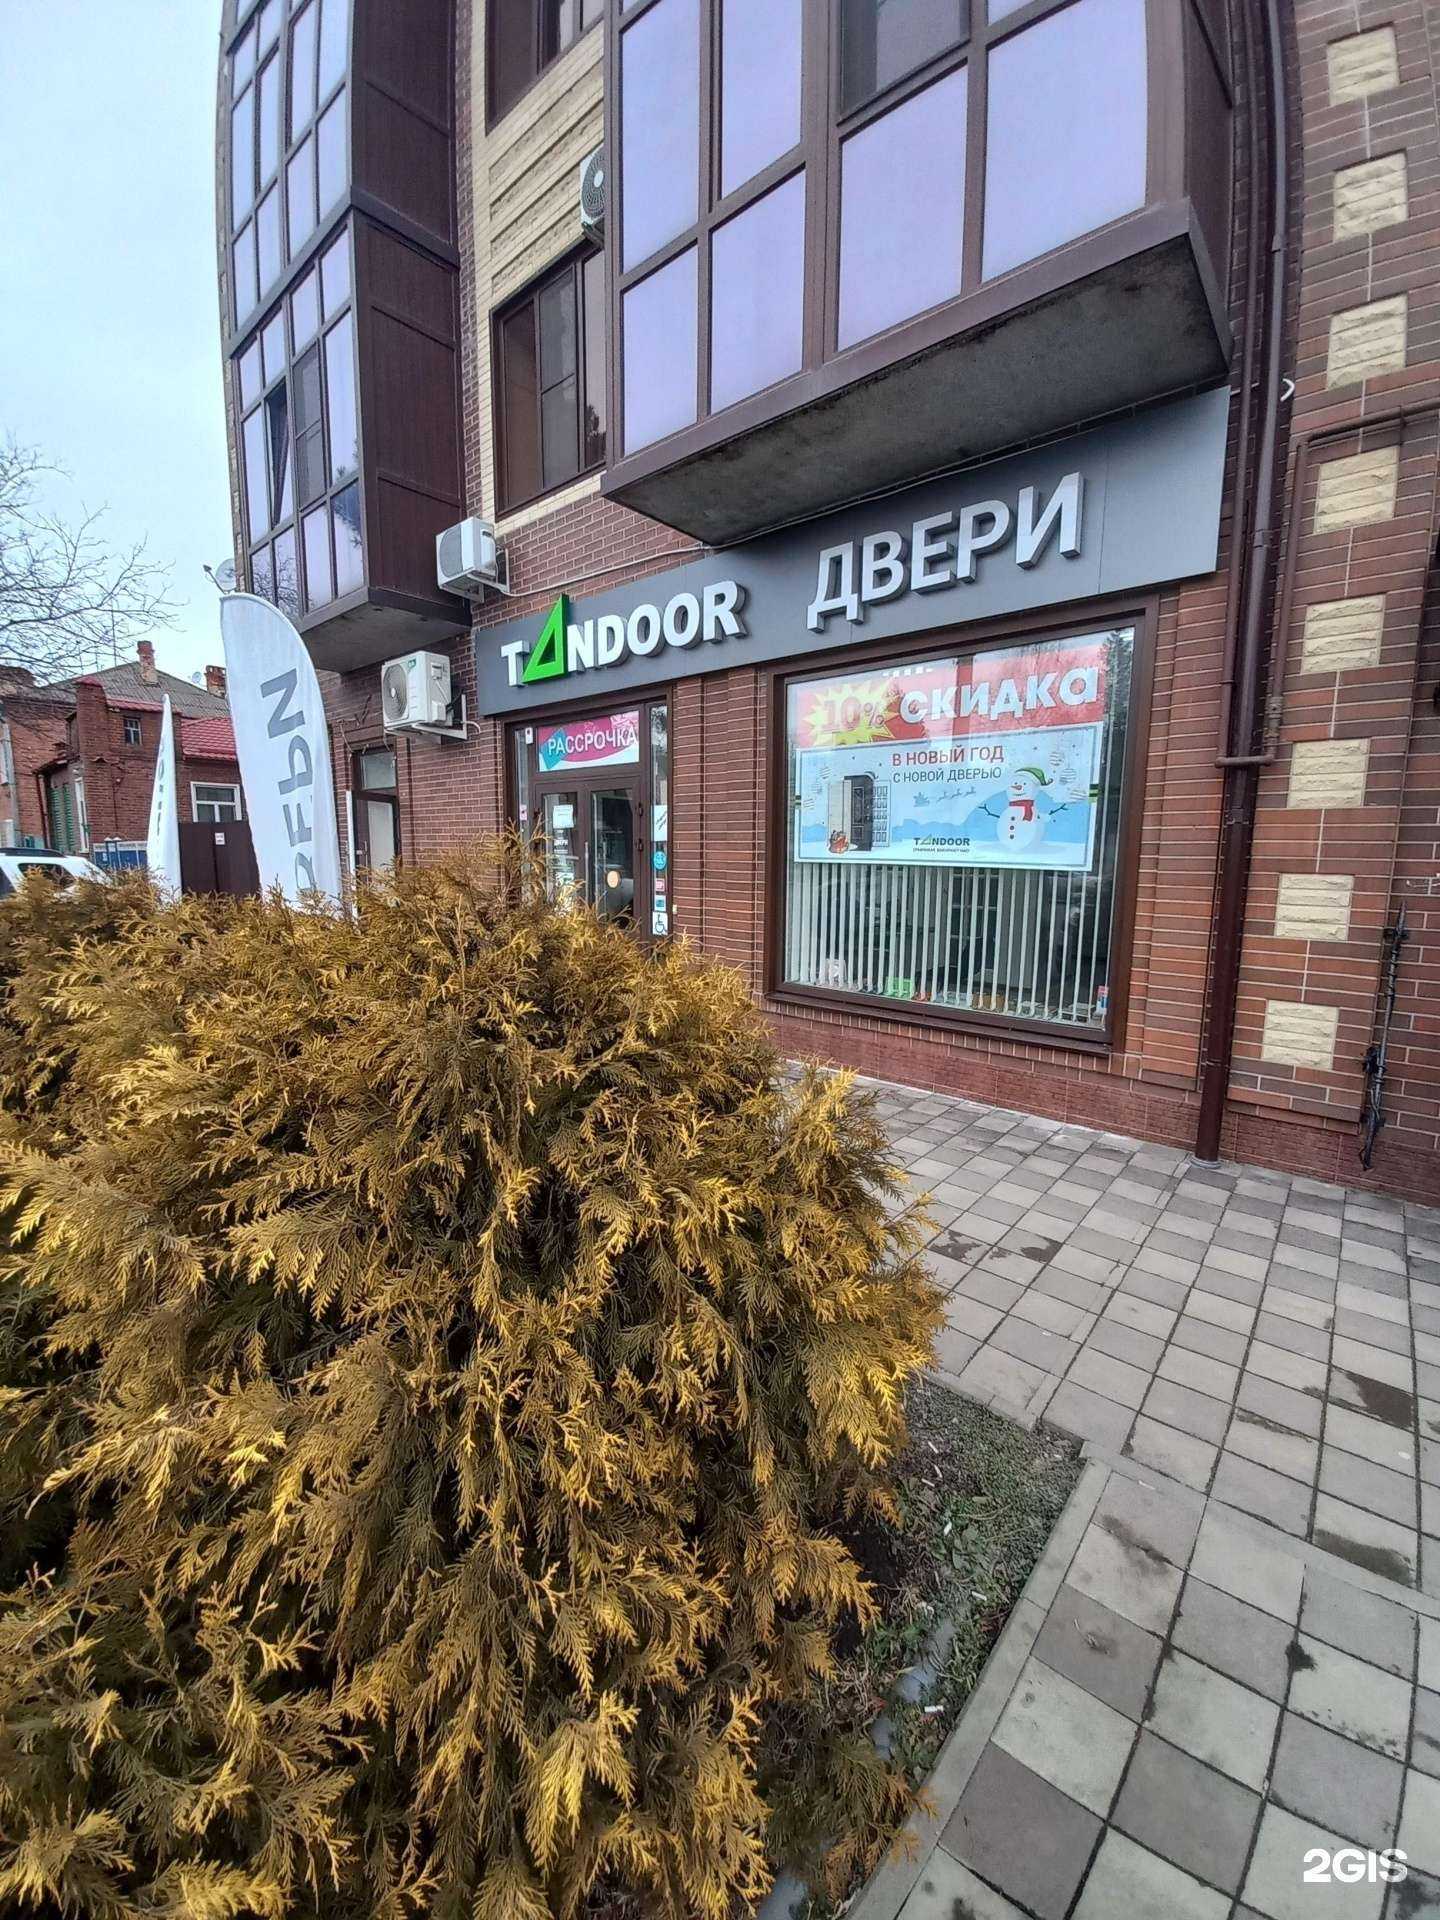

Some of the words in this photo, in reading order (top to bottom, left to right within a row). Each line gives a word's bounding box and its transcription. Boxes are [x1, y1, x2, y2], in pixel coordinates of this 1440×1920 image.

[807, 472, 1082, 632] ДВЕРИ
[820, 697, 885, 732] 10%
[547, 726, 638, 756] РАССРОЧКА
[892, 753, 902, 767] В
[906, 744, 965, 766] НОВЫЙ
[970, 745, 1005, 763] ГОД
[893, 772, 901, 784] С
[903, 768, 944, 783] НОВОЙ
[947, 766, 1002, 783] ДВЕРЬЮ
